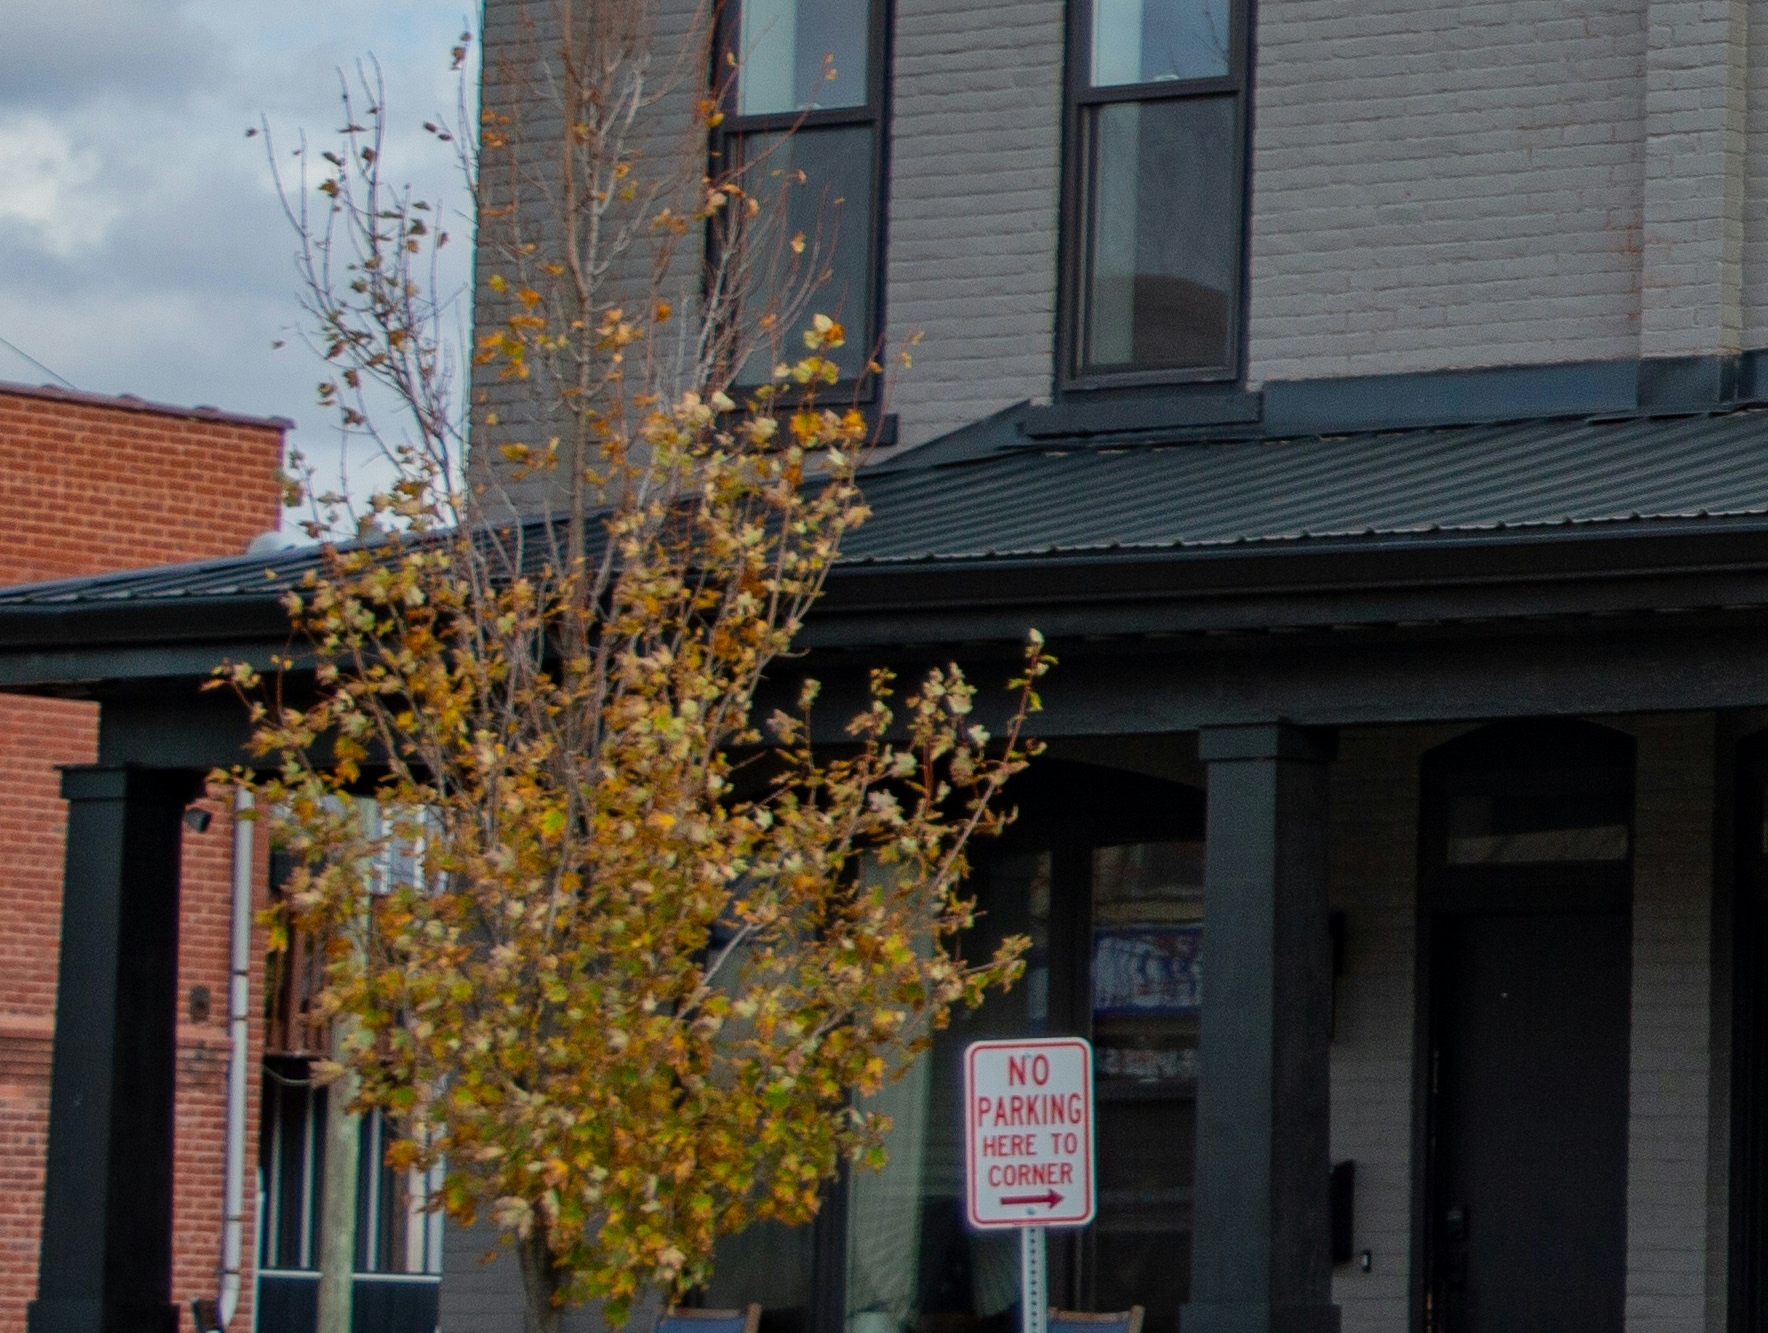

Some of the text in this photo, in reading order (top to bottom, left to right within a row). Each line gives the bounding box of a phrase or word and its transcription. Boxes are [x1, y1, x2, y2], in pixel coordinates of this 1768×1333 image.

[1008, 1053, 1050, 1086] NO
[977, 1092, 1082, 1127] PARKING
[982, 1132, 1078, 1157] HERE TO
[988, 1162, 1073, 1187] CORNER
